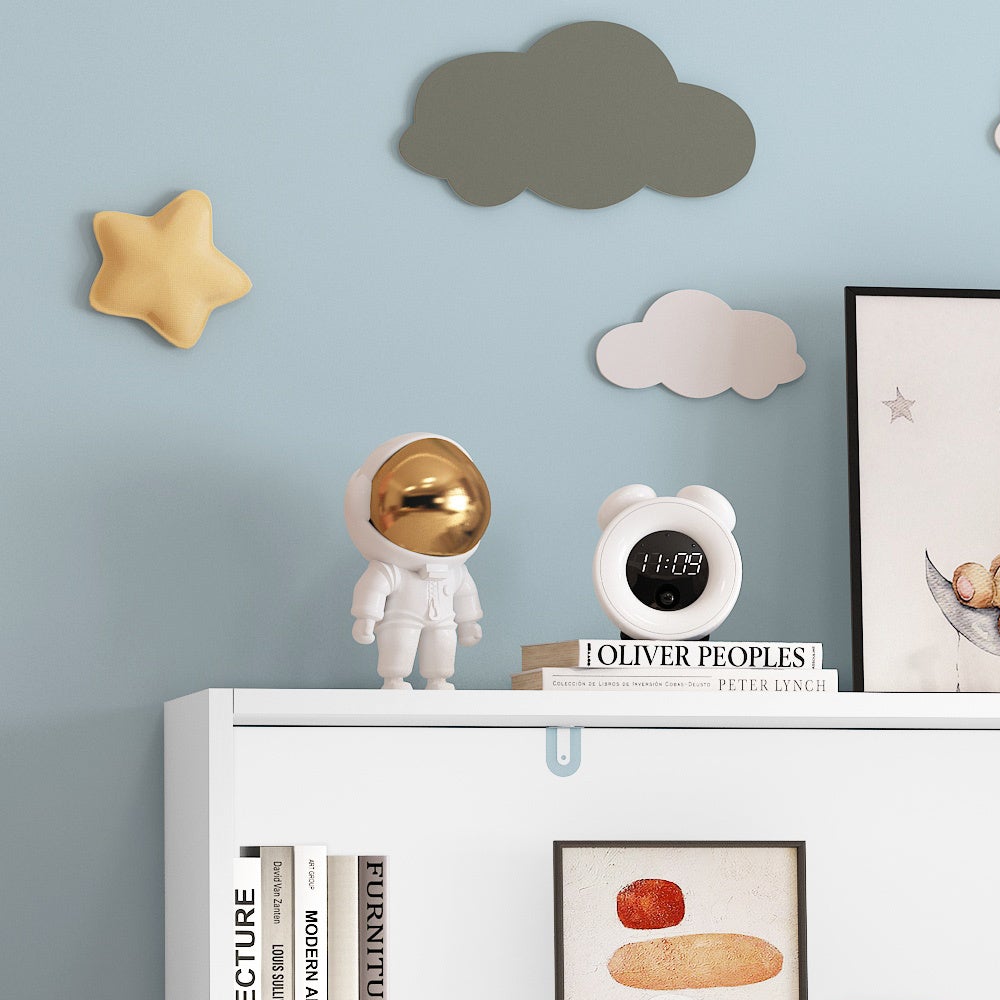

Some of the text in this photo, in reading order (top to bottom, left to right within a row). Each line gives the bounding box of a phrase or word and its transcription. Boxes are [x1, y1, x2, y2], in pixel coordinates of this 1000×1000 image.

[641, 552, 703, 575] 11:09
[597, 644, 691, 667] OLIVER
[698, 646, 805, 669] PEOPLES
[718, 678, 827, 692] PETER LYNCH
[272, 861, 283, 882] David
[273, 899, 282, 925] Zanten
[271, 944, 285, 972] LOUIS
[305, 910, 318, 981] MODERN
